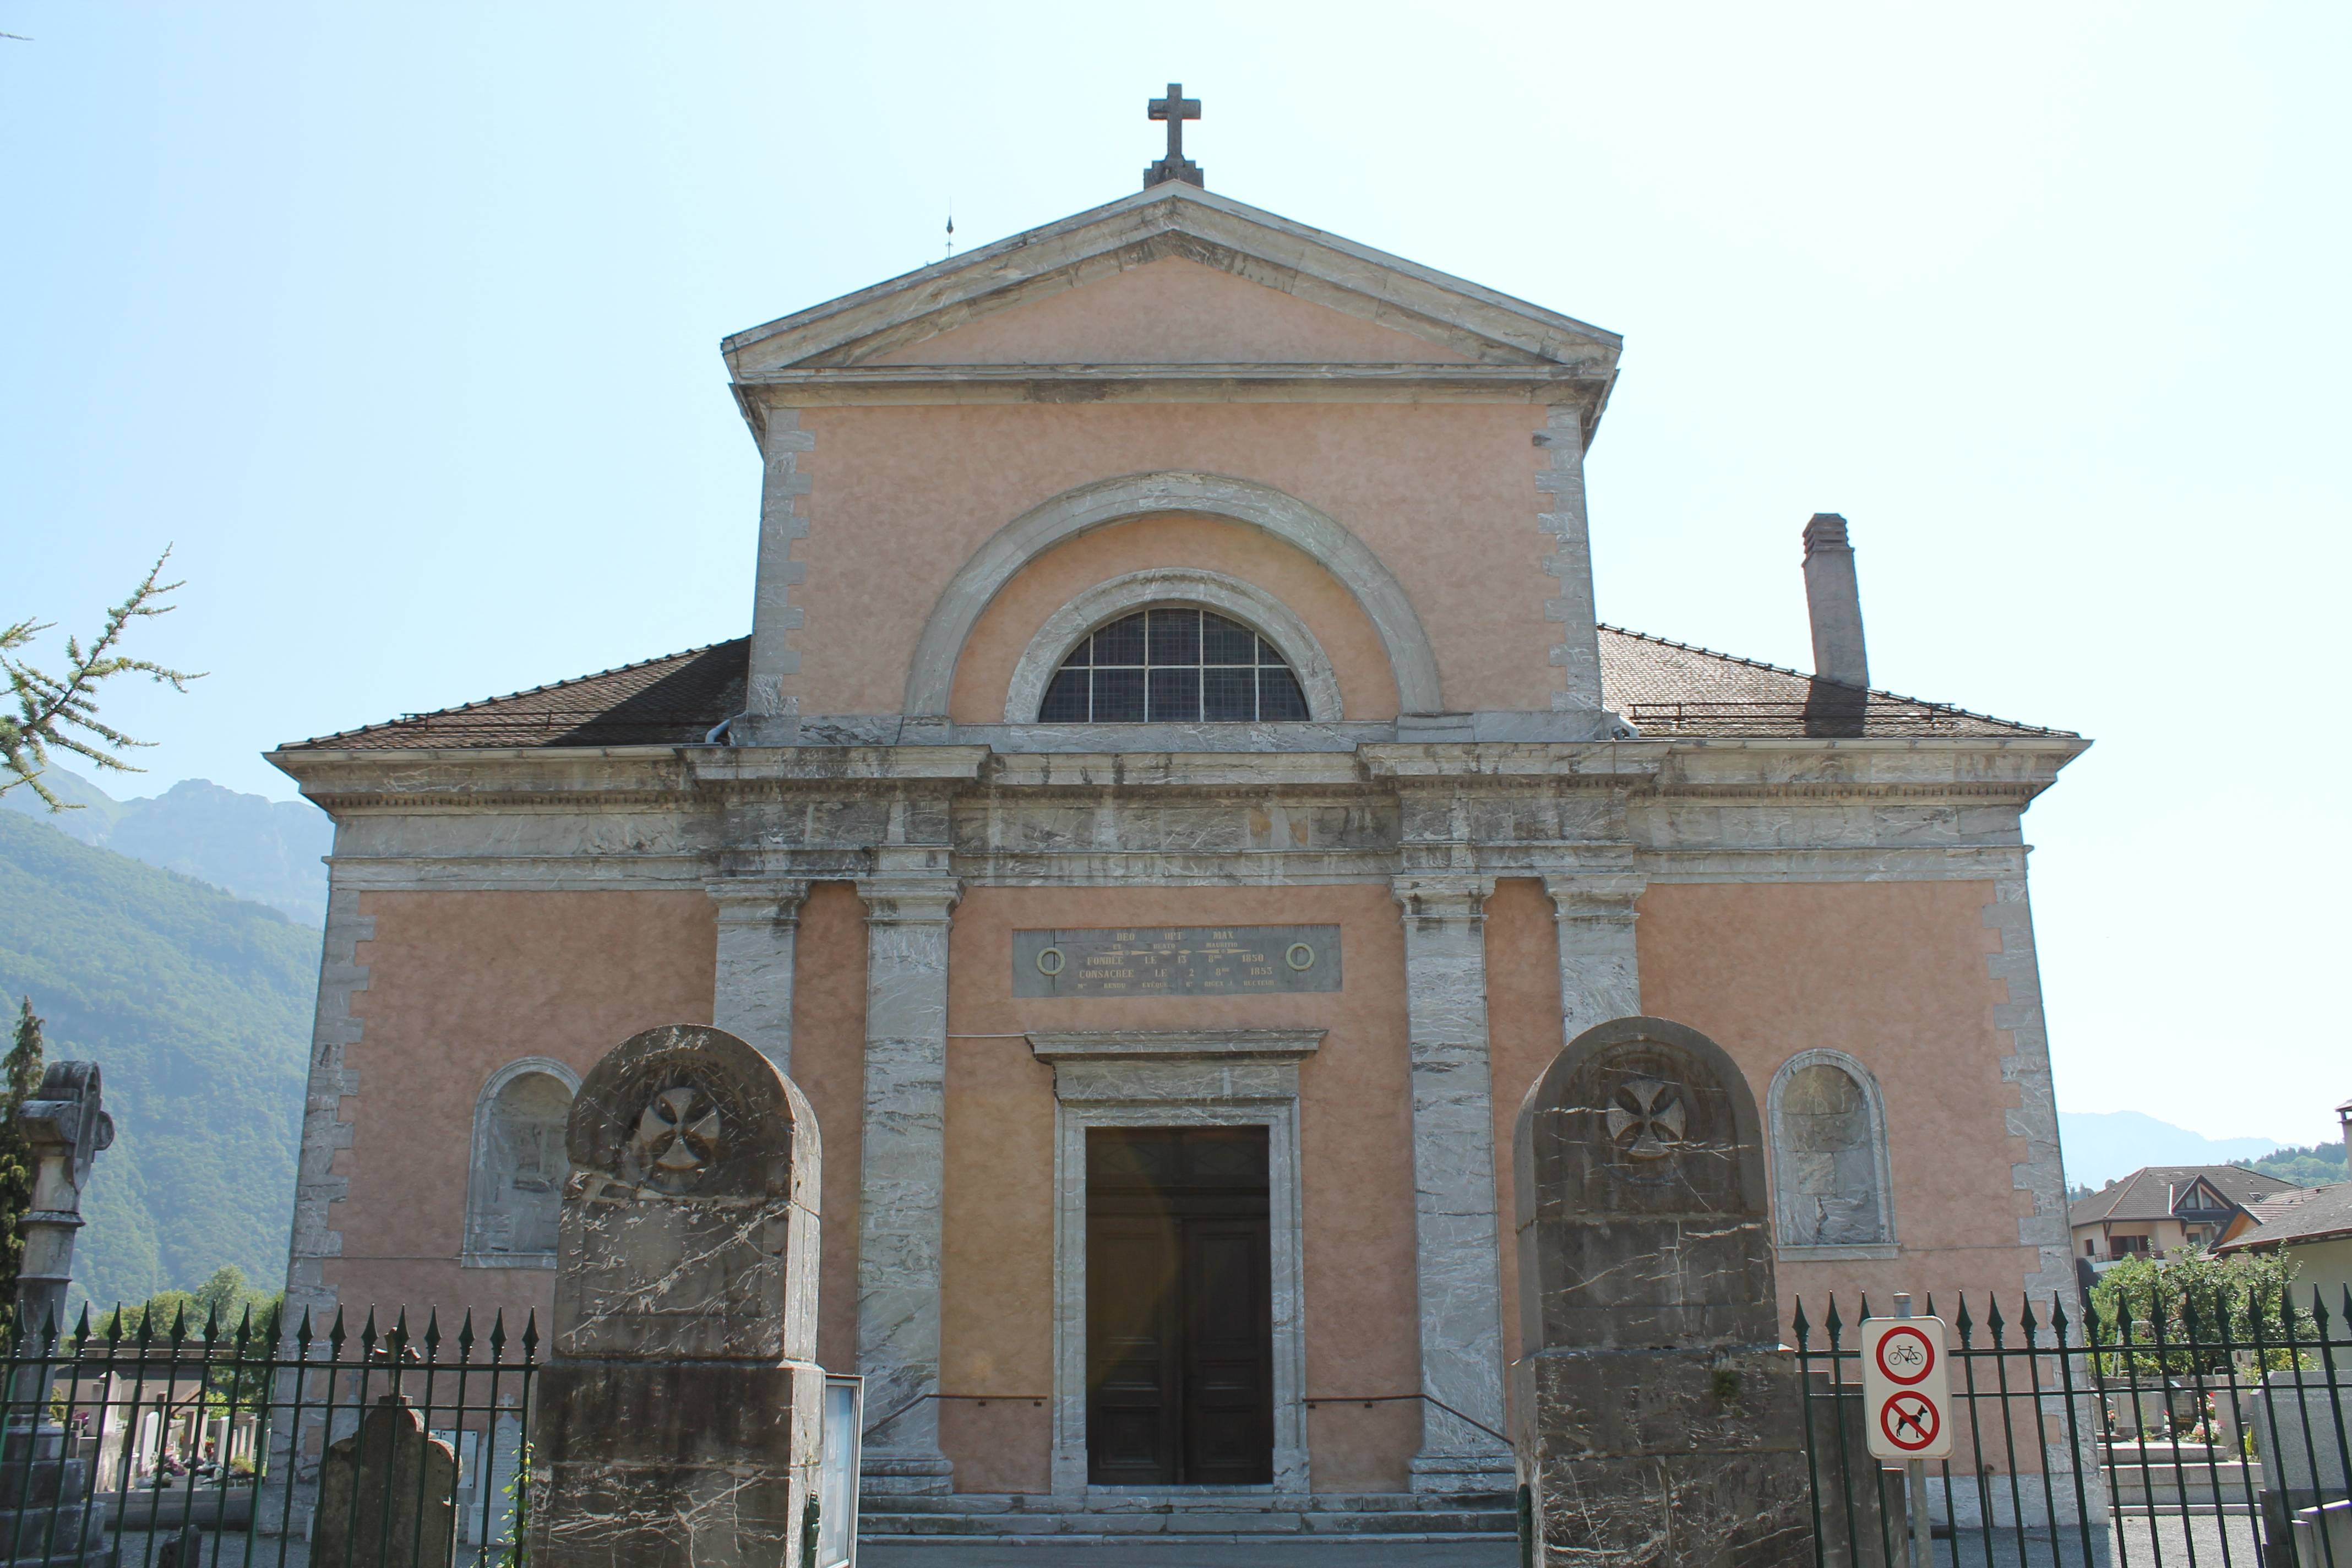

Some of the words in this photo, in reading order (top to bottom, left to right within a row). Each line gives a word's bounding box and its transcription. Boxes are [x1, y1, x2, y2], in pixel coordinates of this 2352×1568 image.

[1117, 932, 1135, 941] DEO
[1164, 932, 1183, 940] OPT
[1213, 931, 1234, 940] MAX
[1145, 955, 1157, 965] LE
[1178, 955, 1187, 963] 13
[1242, 954, 1264, 962] 1850
[1079, 968, 1135, 978] CONSACRÉE
[1155, 968, 1168, 978] LE
[1189, 968, 1194, 977] 2
[1250, 966, 1273, 976] 1853
